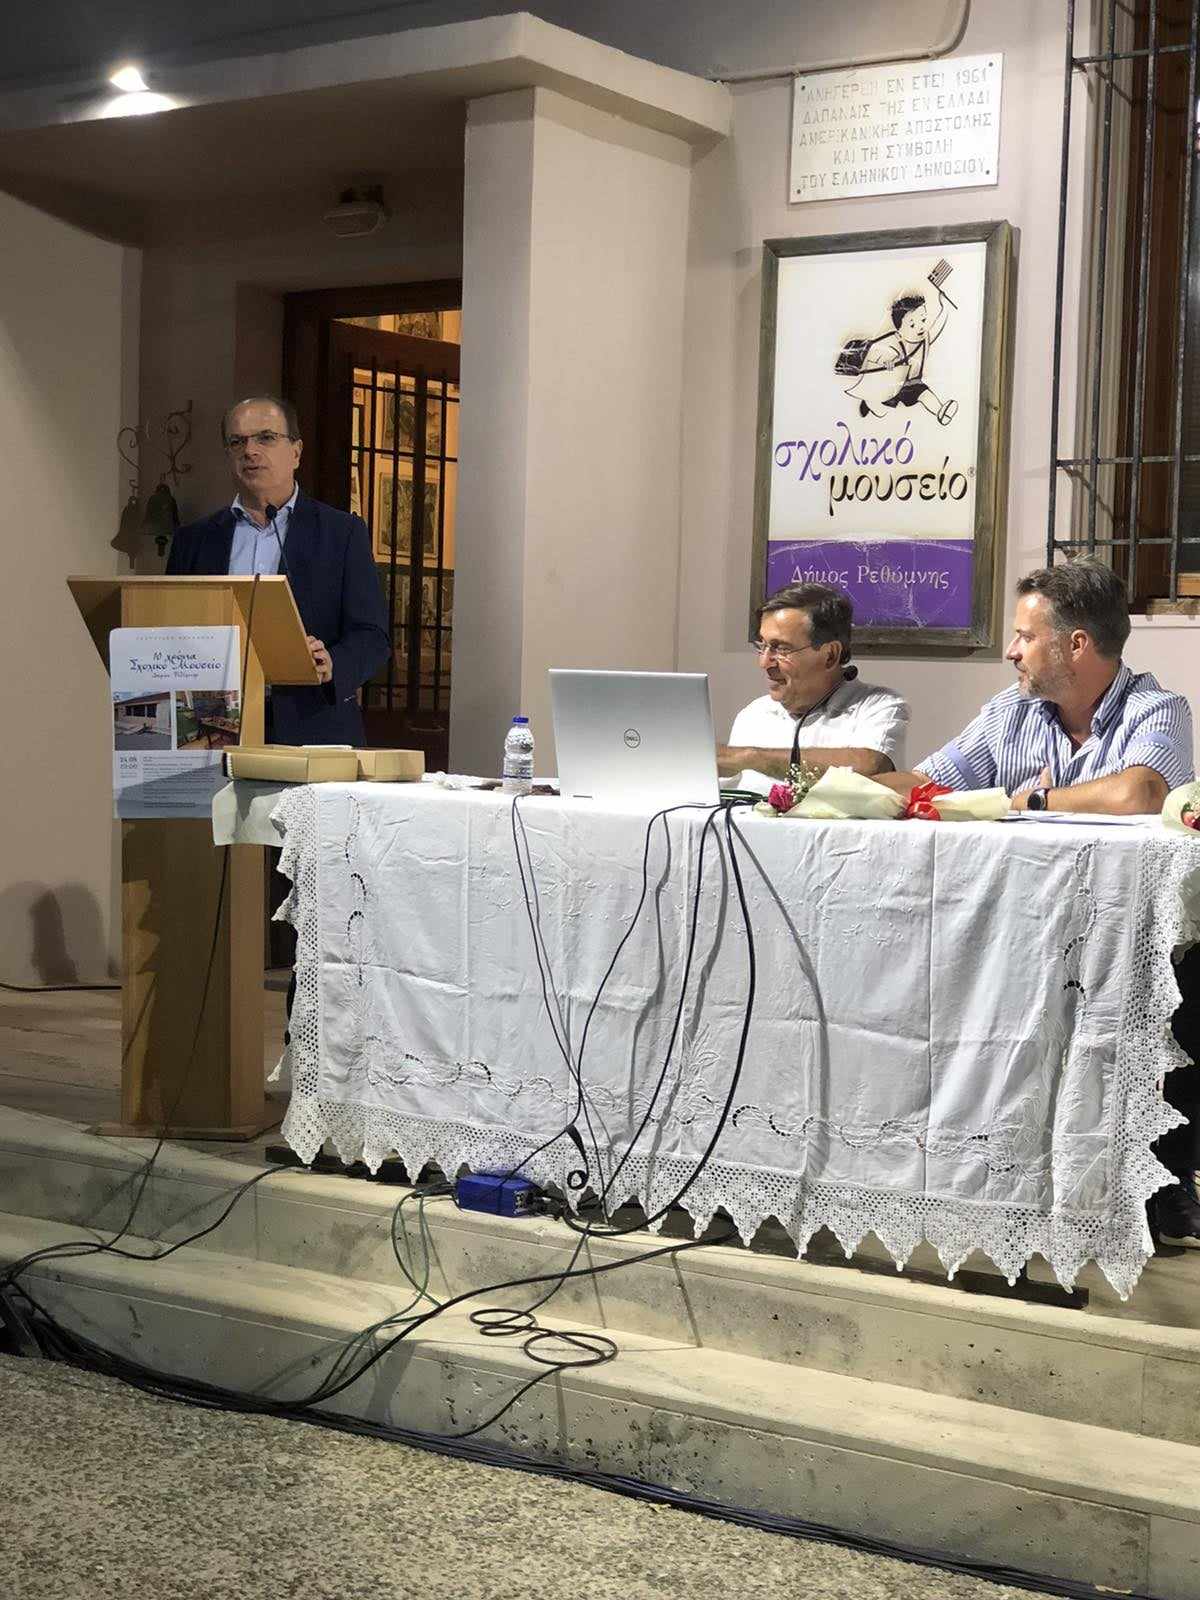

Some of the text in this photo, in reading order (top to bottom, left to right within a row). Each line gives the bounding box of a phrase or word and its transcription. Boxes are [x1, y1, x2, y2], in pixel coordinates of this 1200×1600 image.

[886, 78, 905, 94] ΕΝ
[912, 73, 945, 90] ΕΤΕΙ
[956, 67, 988, 86] 1961
[803, 90, 991, 125] ΔΑΠΑΝΑΙΣ ΤΗΣ ΕΝ ΕΛΛΑΔΙ
[905, 112, 993, 134] ΑΠΟΣΤΟΛΗΣ
[833, 138, 953, 166] ΚΑΙ ΤΗ ΣΥΜΒΟΛΗ
[801, 157, 986, 190] ΤΟΥ ΕΛΛΗΝΙΚΟΥ ΔΗΜΟΣΙΟΥ
[775, 420, 914, 482] σχολικό
[829, 456, 968, 517] μουσείο
[791, 564, 950, 589] Δήμος Ρεθύμνης
